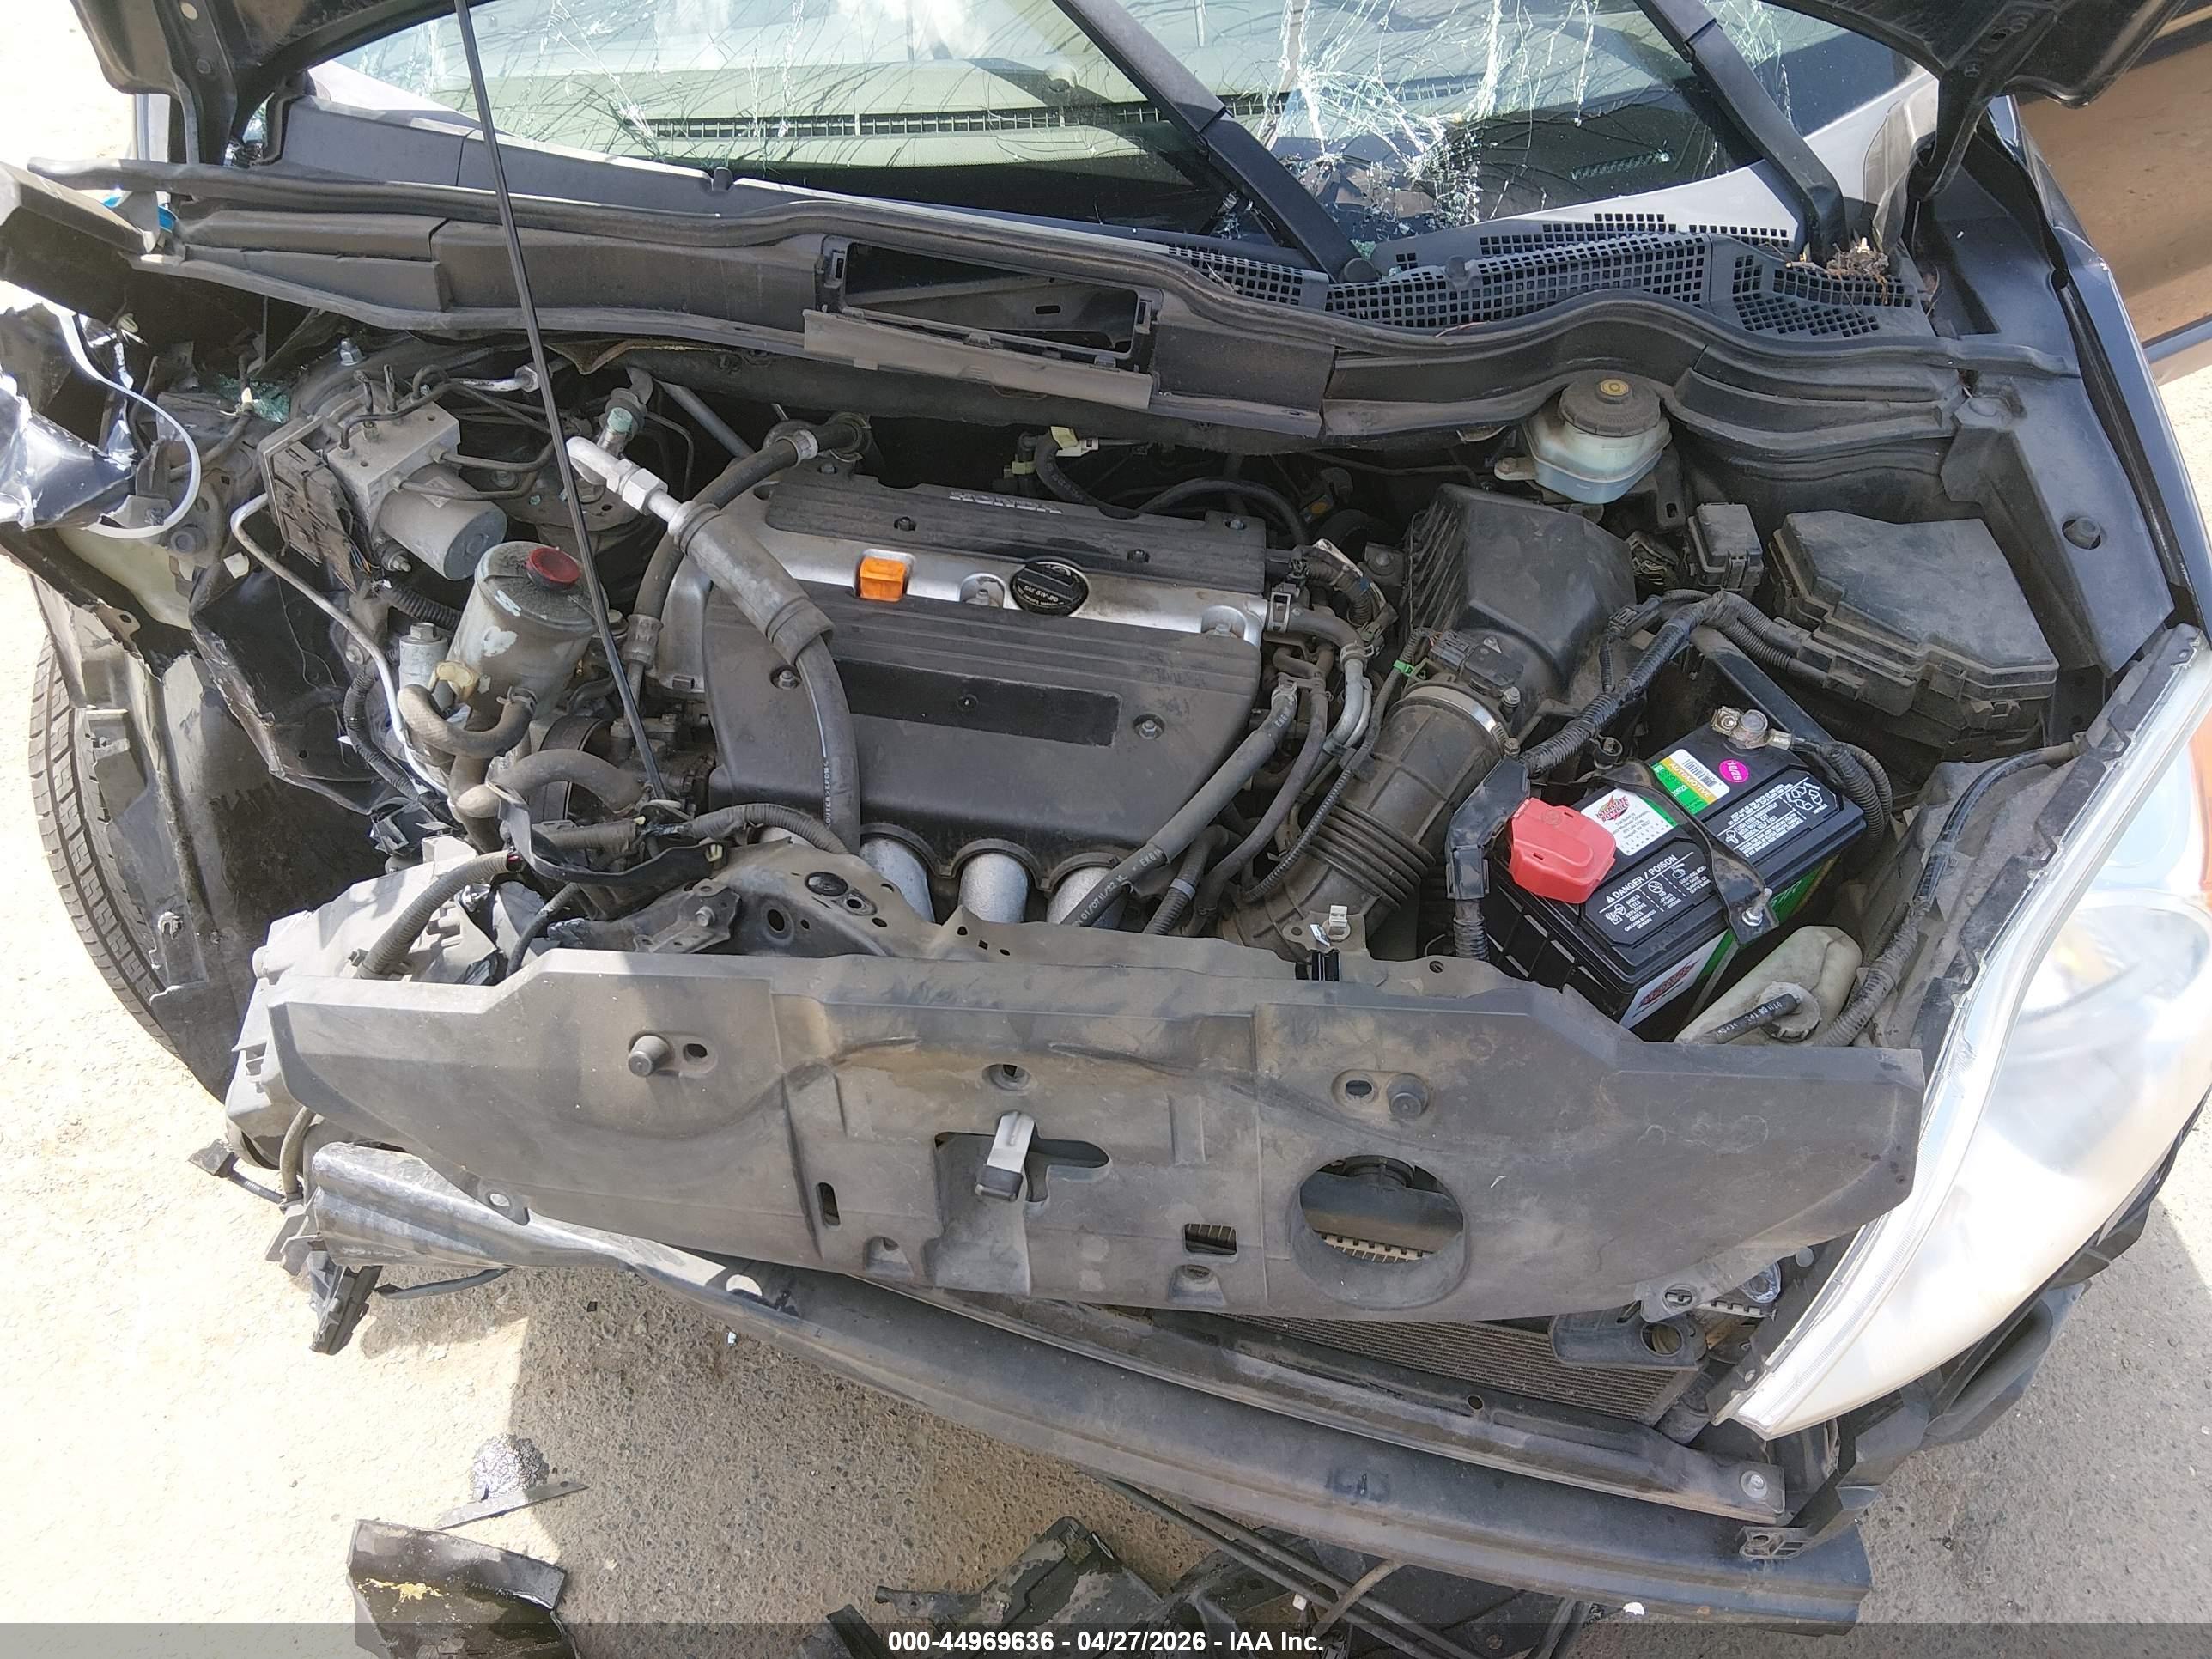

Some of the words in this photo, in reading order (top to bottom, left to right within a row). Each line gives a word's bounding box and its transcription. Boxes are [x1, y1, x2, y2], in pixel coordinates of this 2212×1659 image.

[1669, 763, 1711, 798] AUTOMOTIVE
[1727, 761, 1742, 781] 10/25
[1612, 877, 1645, 898] DANGER
[1649, 855, 1678, 875] POISON
